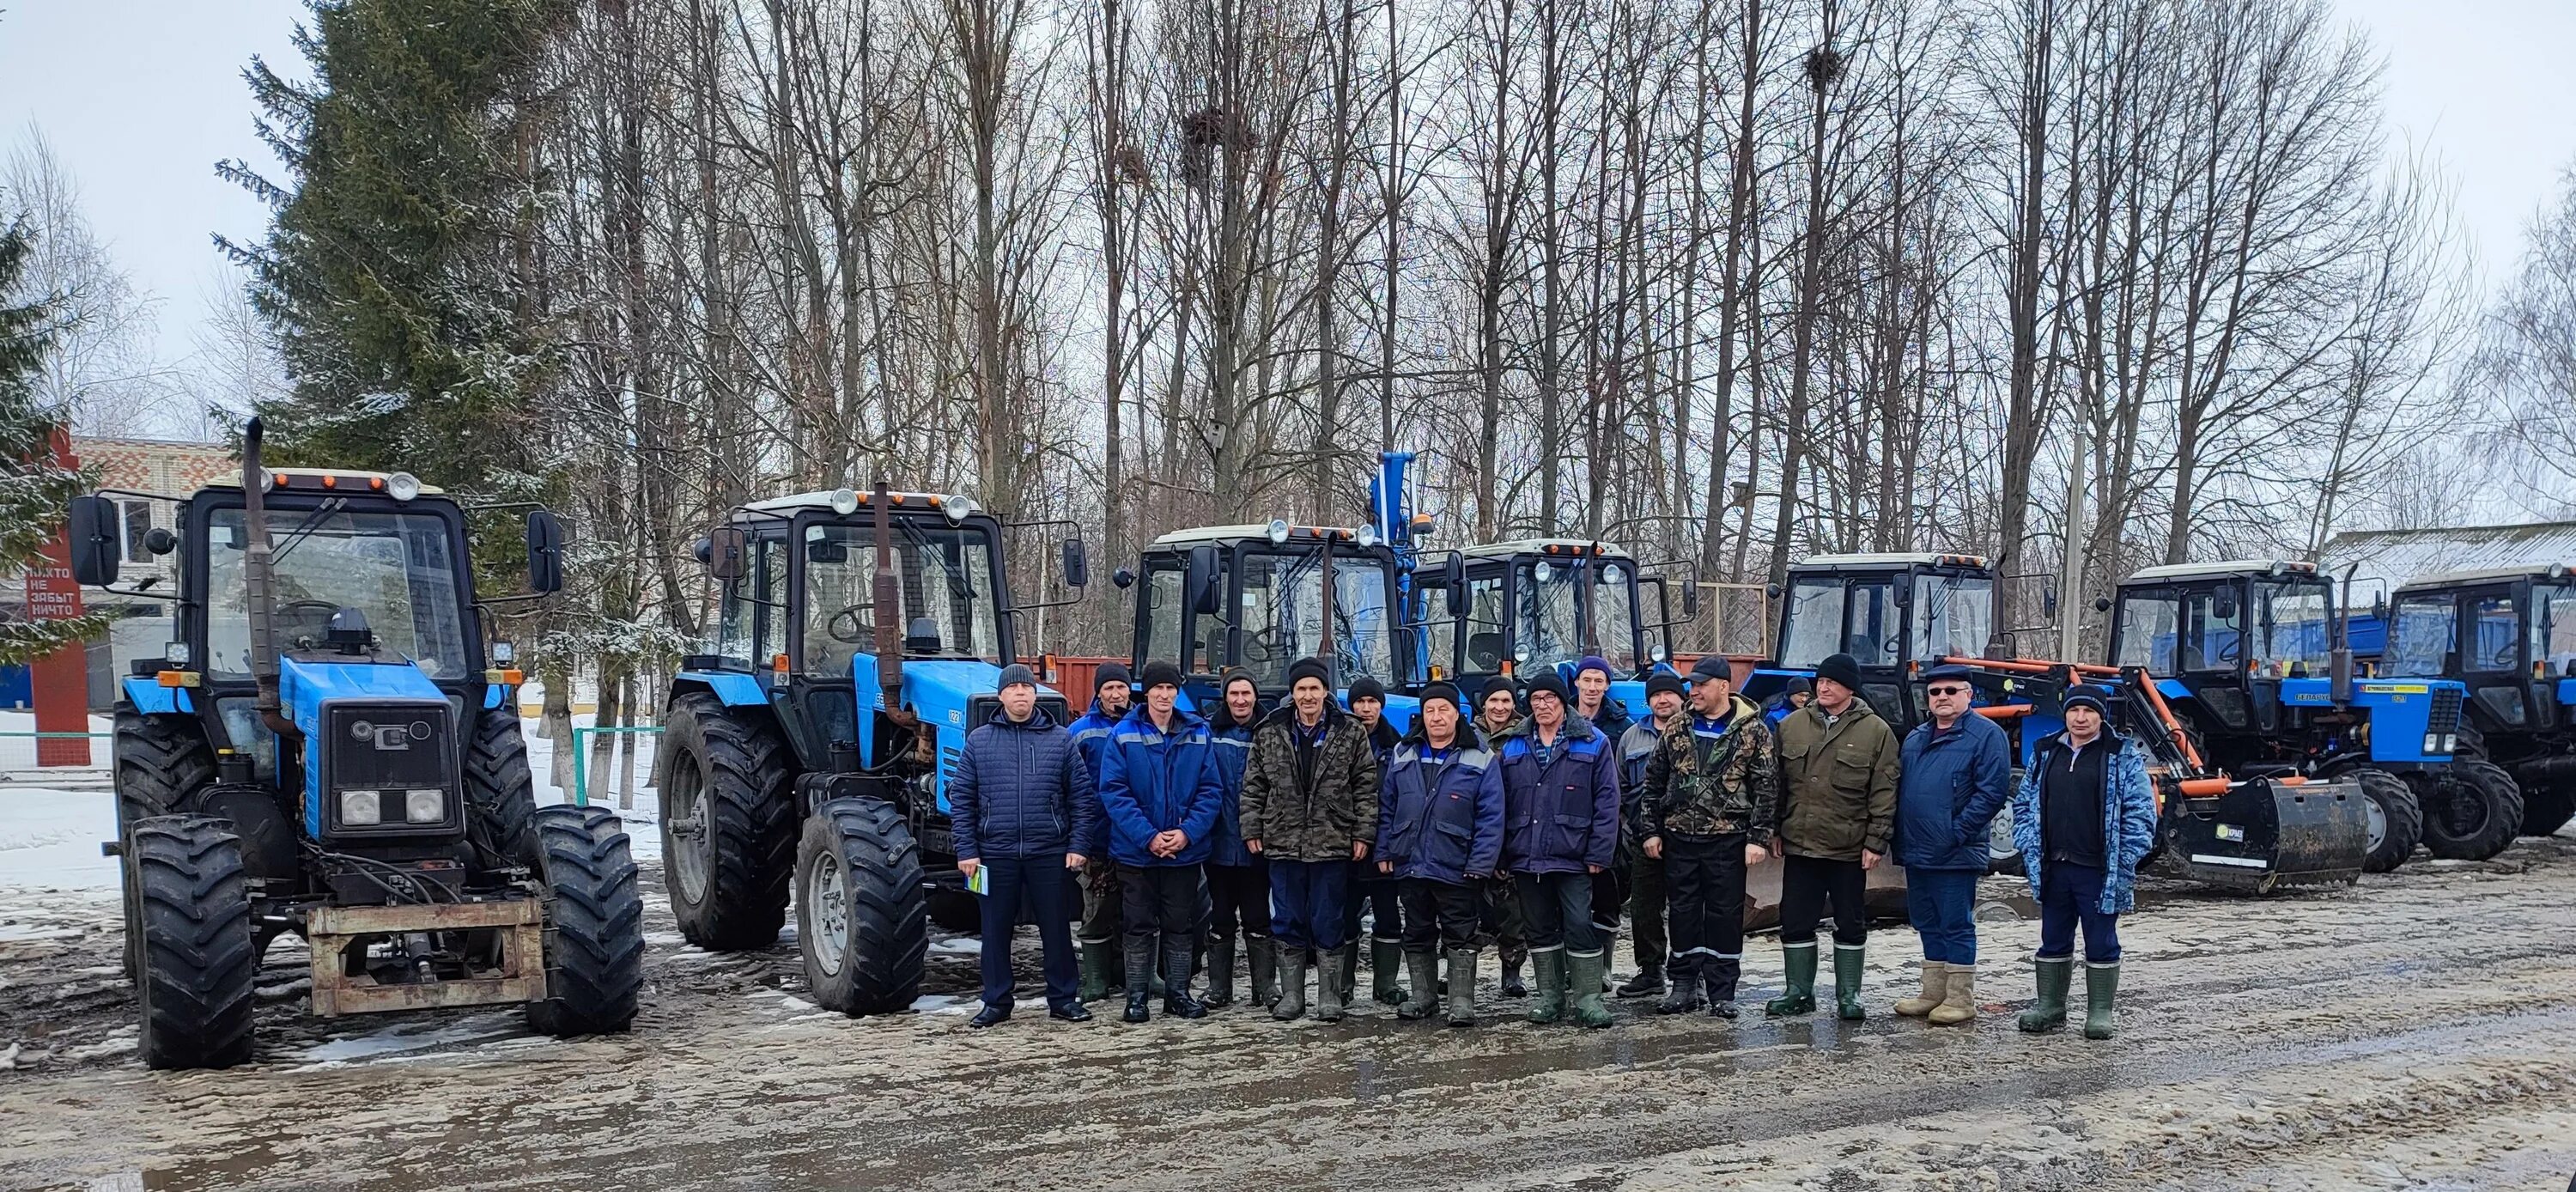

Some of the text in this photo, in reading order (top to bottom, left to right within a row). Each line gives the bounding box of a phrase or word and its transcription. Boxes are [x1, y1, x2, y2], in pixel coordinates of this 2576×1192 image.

[30, 580, 47, 590] НЕ
[31, 593, 74, 604] ЗАБЫТ
[32, 605, 73, 616] НИЧТО
[950, 711, 961, 722] 1221
